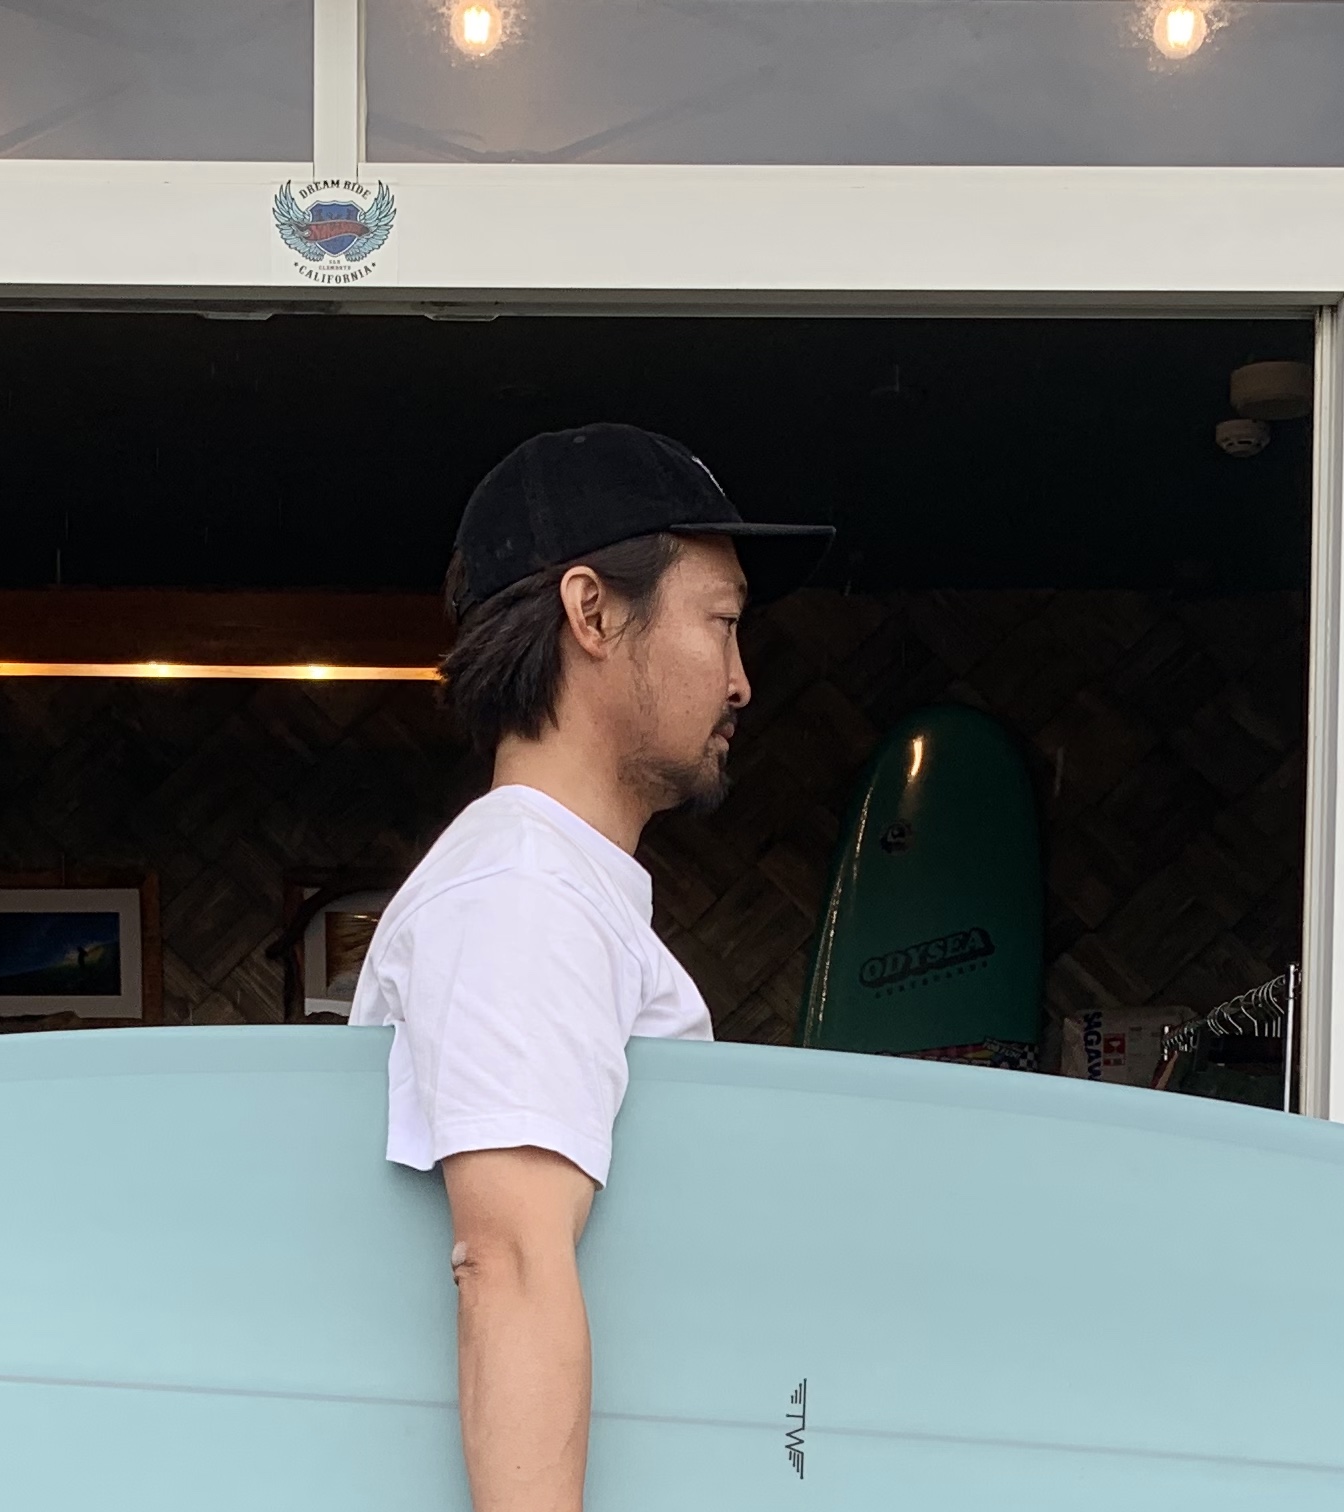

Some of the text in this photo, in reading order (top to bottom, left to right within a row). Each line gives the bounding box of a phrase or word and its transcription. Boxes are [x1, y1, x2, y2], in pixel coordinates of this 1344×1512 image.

[299, 179, 371, 200] DREAM RIDE
[298, 264, 373, 284] CALIFORNIA
[860, 928, 993, 987] ODYSEA
